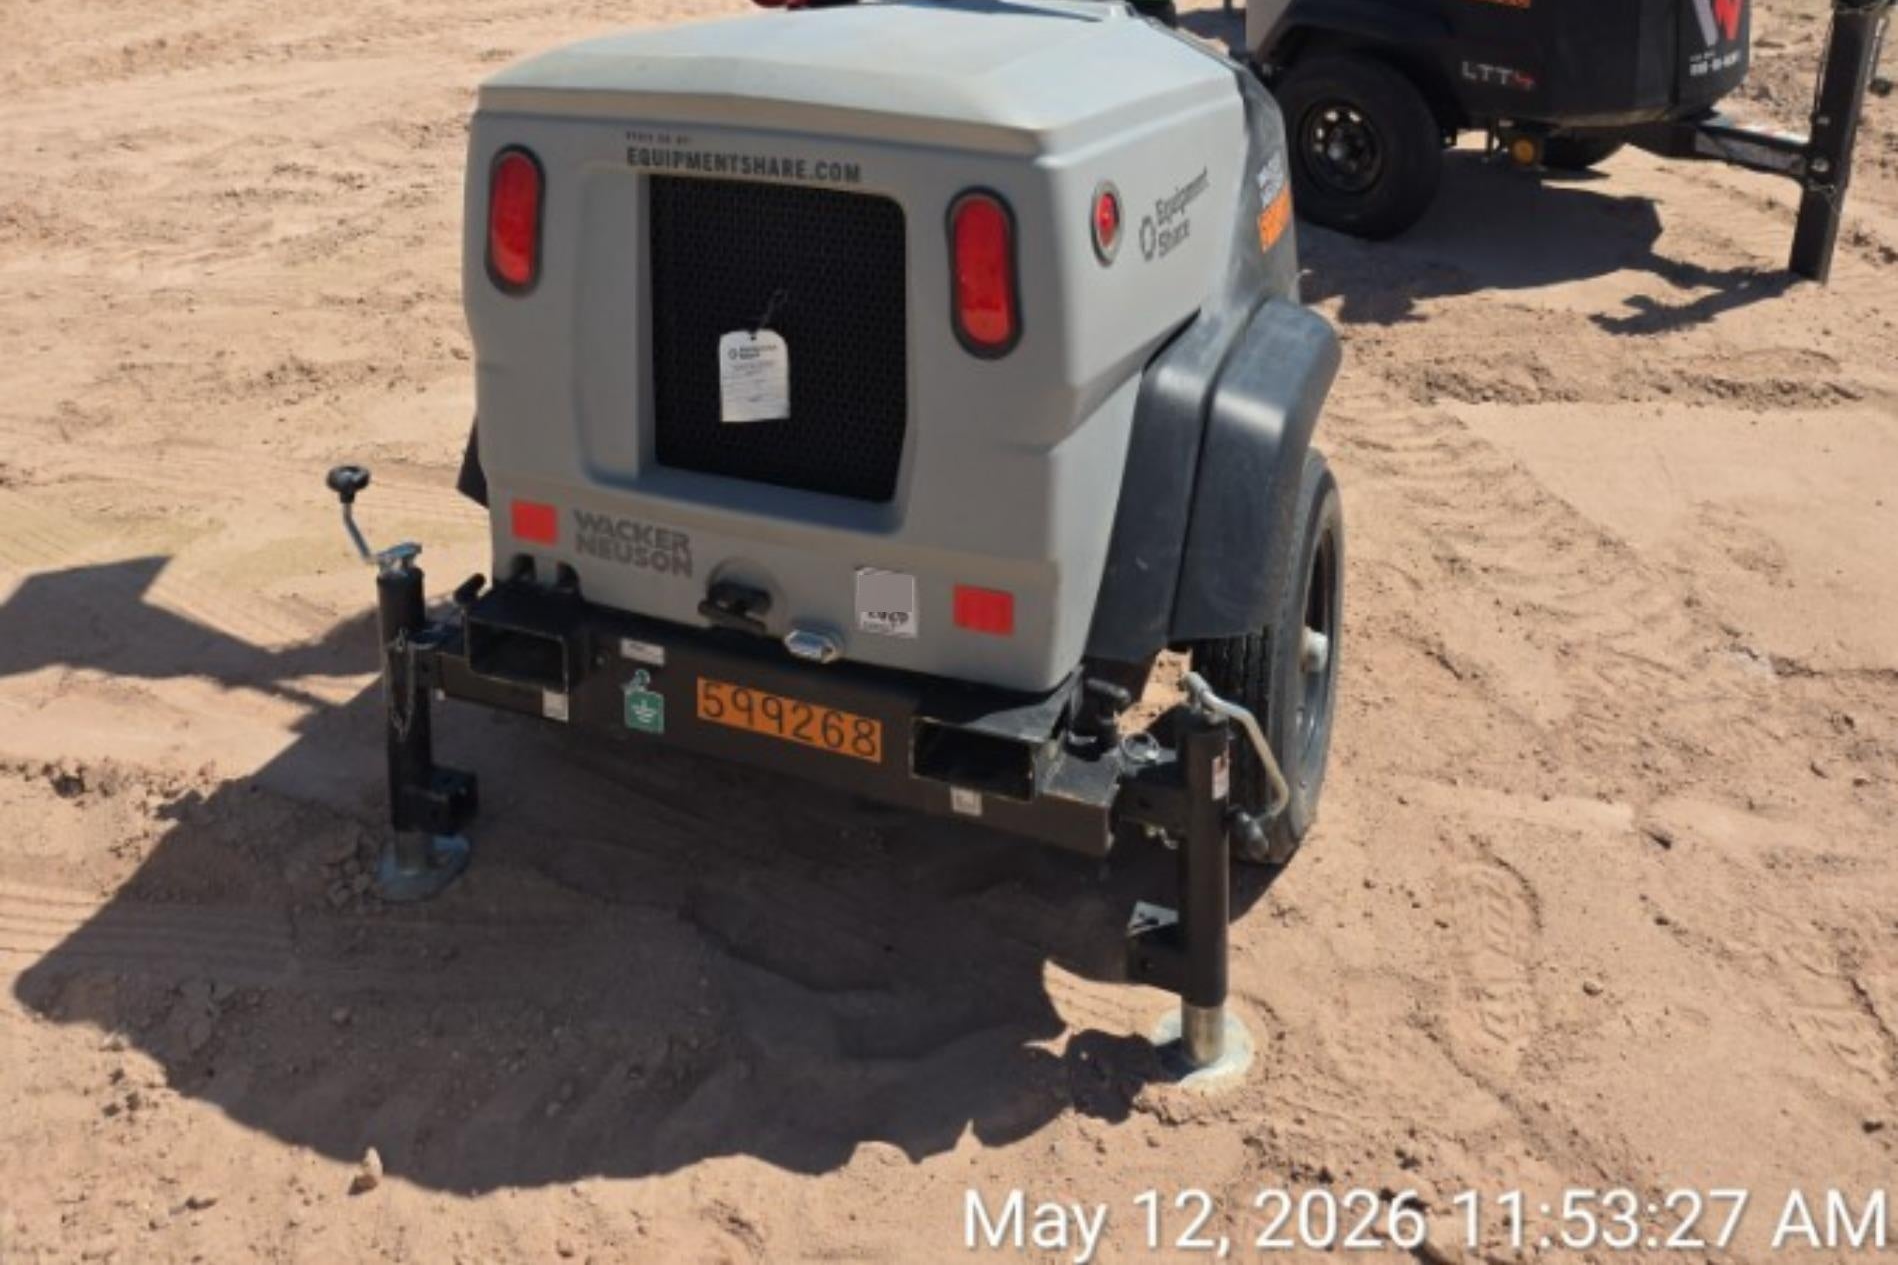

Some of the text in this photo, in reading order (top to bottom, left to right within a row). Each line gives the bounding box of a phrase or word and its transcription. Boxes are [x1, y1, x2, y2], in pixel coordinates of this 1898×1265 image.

[626, 146, 862, 183] EQUIPMENTSHARE.COM
[572, 508, 691, 552] WACKER
[575, 533, 694, 578] NEUSON
[702, 682, 877, 758] 599268
